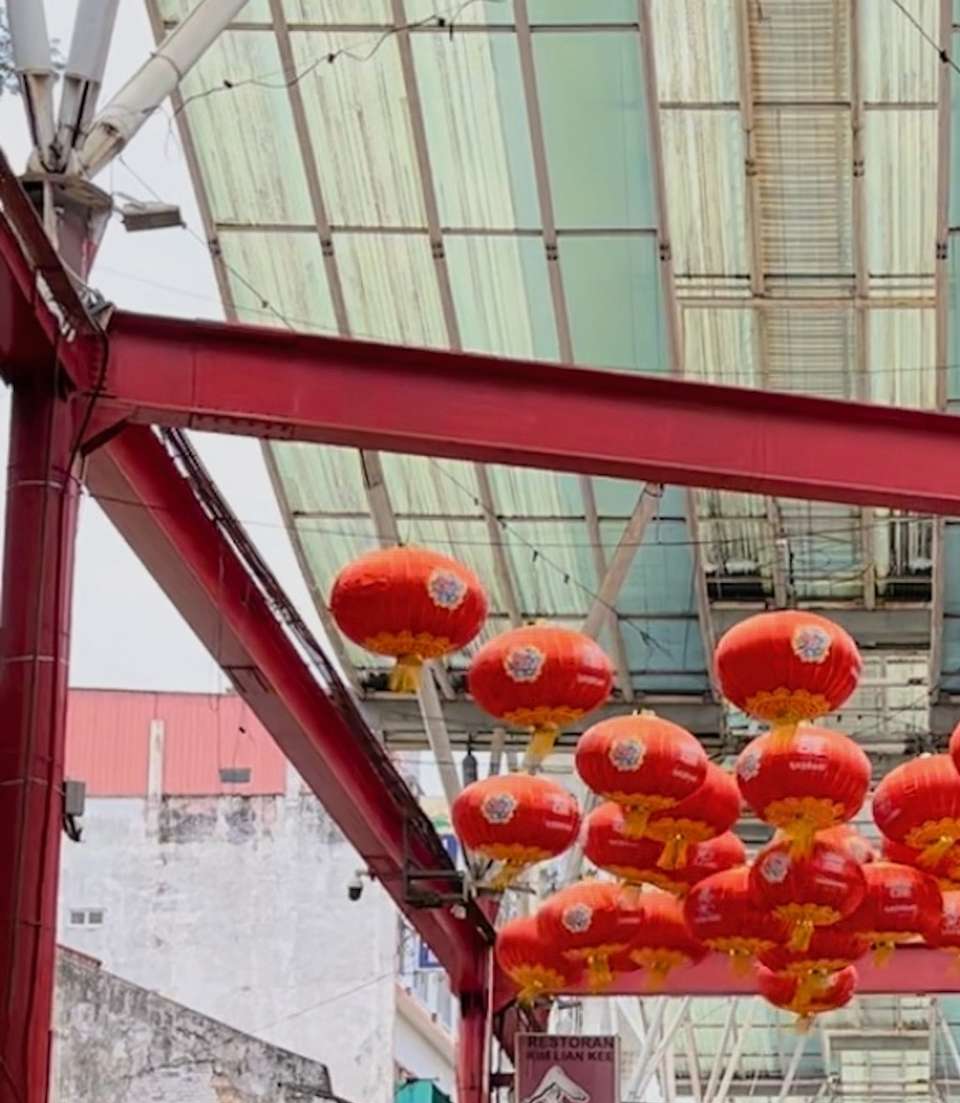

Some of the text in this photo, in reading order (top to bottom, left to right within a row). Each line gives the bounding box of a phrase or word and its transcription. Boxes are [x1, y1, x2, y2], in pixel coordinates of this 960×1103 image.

[528, 1036, 615, 1049] RESTORAN
[554, 1052, 584, 1062] LIAN
[587, 1052, 614, 1062] KEE
